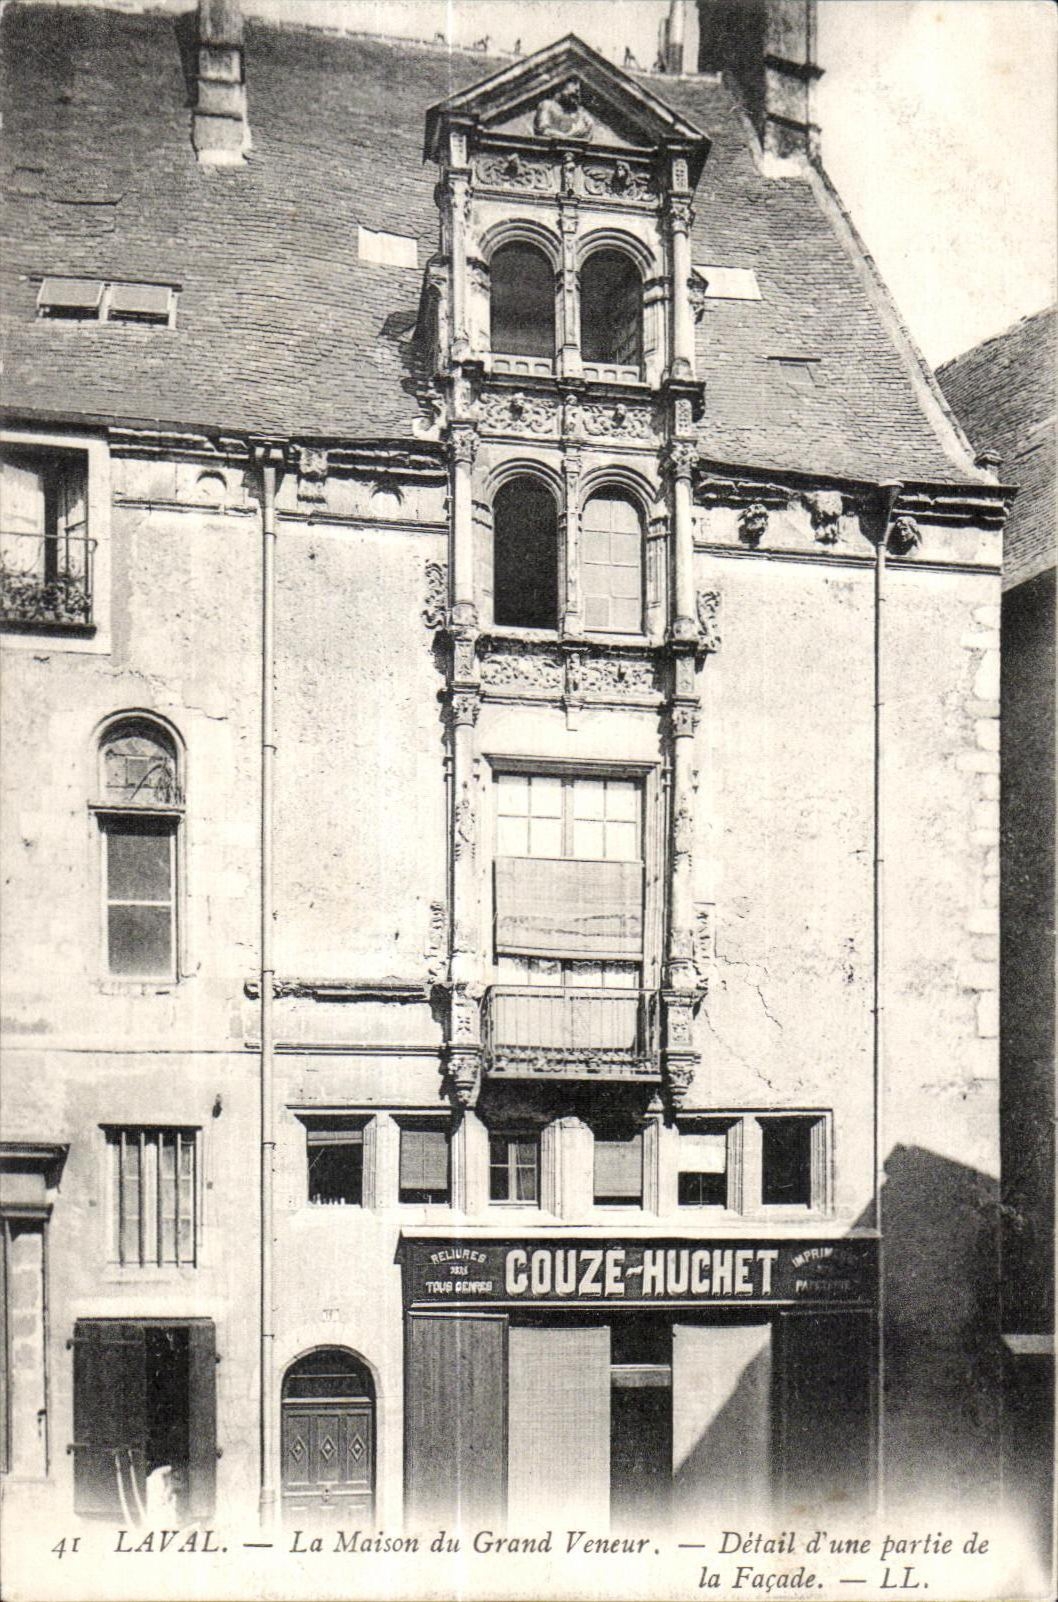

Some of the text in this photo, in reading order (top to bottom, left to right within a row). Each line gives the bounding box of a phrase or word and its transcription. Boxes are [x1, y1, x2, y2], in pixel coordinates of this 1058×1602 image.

[430, 1247, 487, 1265] RELIURES
[425, 1281, 493, 1294] TOUS GENRES
